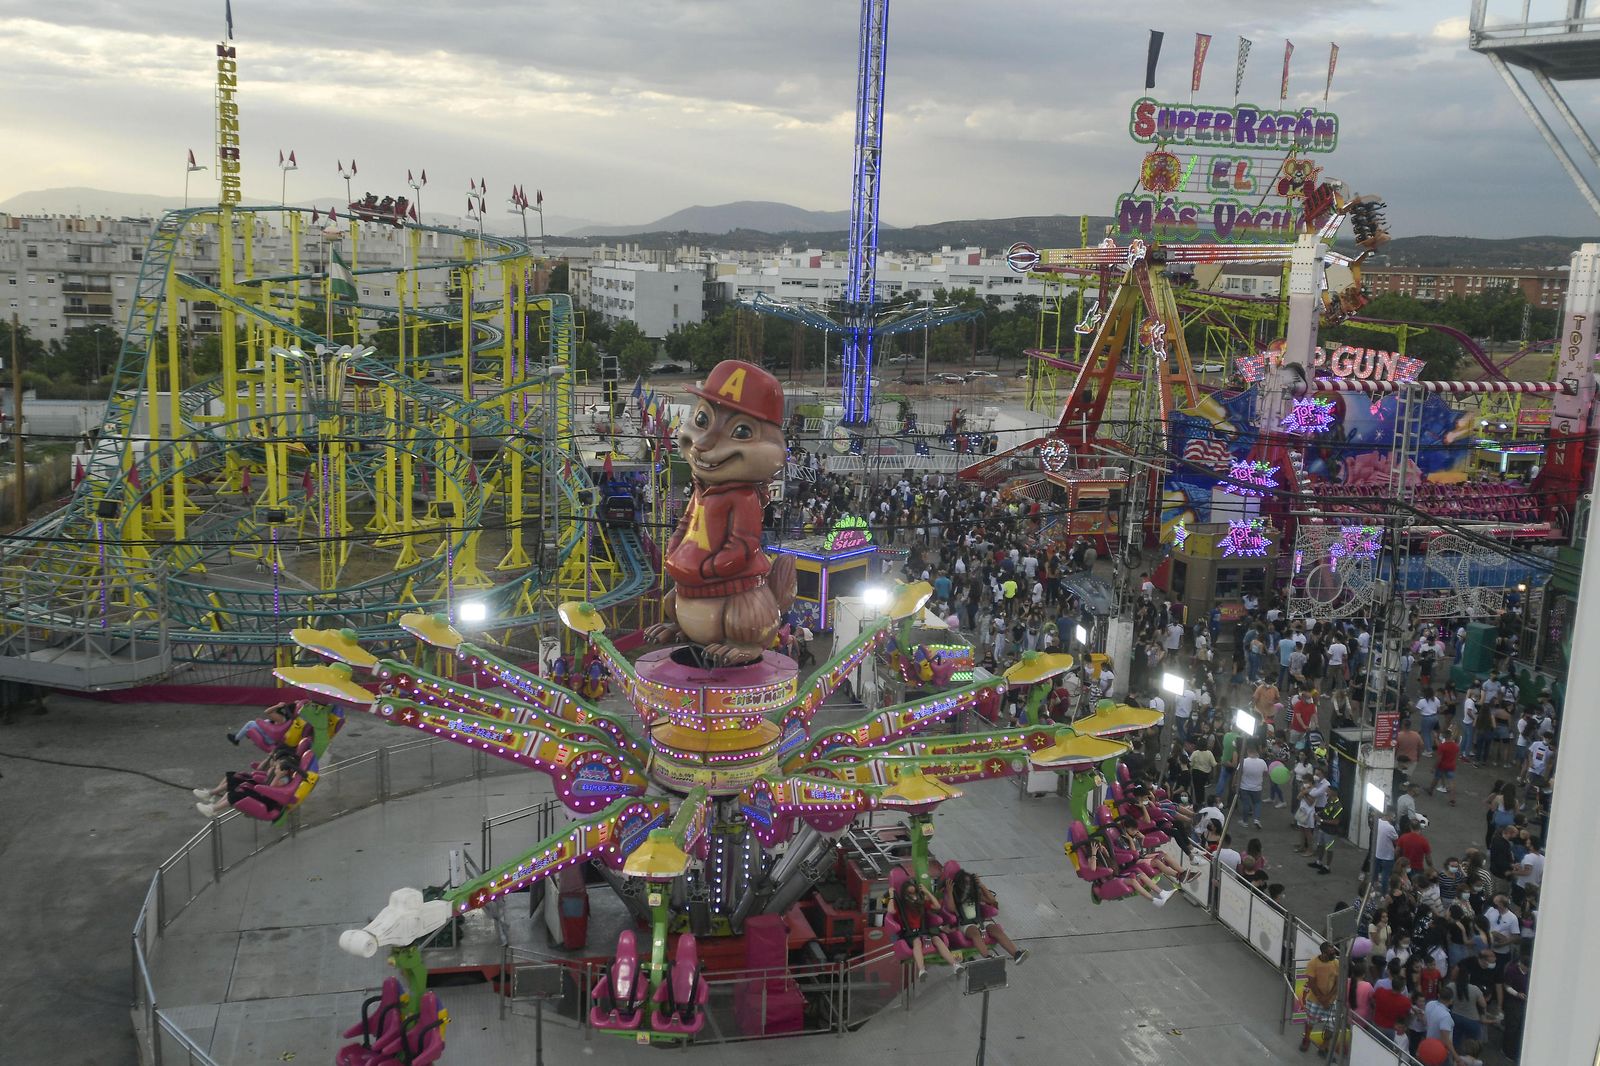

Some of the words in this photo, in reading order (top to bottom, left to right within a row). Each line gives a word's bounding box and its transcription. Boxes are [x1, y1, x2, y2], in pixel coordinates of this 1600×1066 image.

[1212, 161, 1251, 189] EL
[1119, 198, 1198, 238] MÁS
[1567, 315, 1586, 361] TOP
[1262, 347, 1326, 370] TP
[1331, 345, 1399, 382] GUN
[718, 367, 747, 402] A
[680, 502, 712, 552] A
[833, 537, 865, 550] Star
[836, 530, 856, 542] Jet
[1230, 527, 1252, 543] TOP
